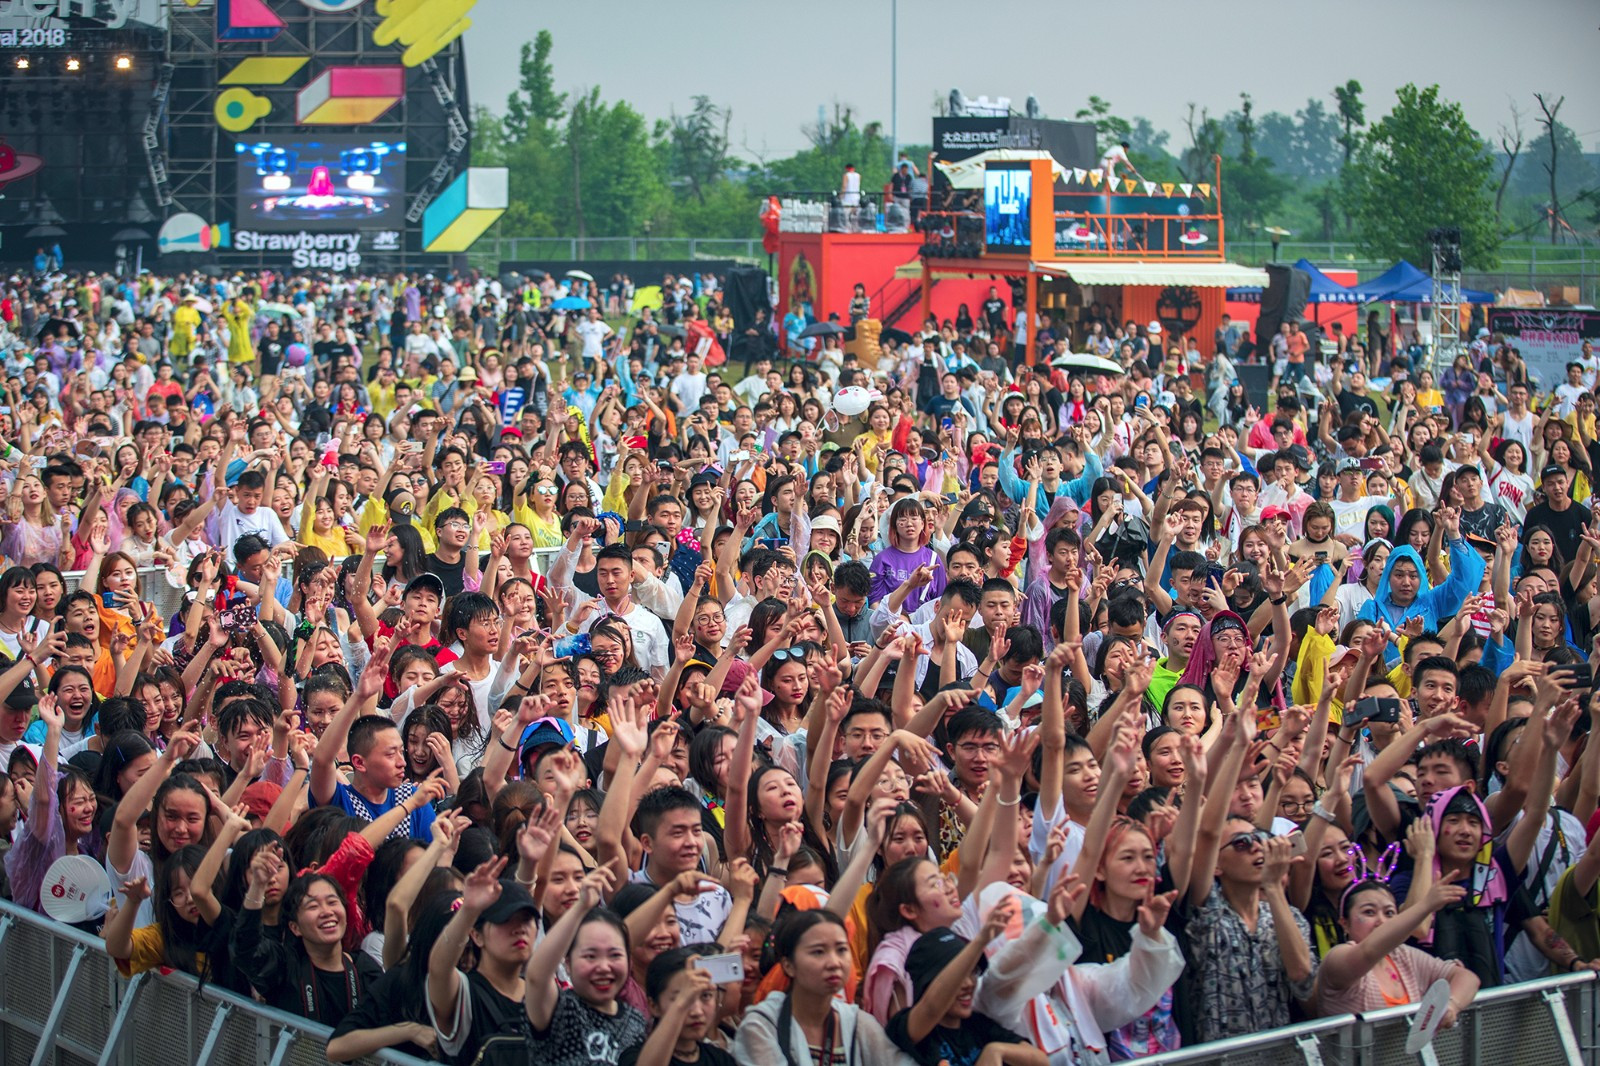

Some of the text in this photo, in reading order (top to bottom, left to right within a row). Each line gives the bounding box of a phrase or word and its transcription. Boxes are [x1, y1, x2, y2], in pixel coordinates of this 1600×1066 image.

[0, 29, 65, 46] al 2018
[234, 230, 361, 252] Strawberry
[292, 249, 361, 272] Stage
[305, 984, 314, 1012] Canon
